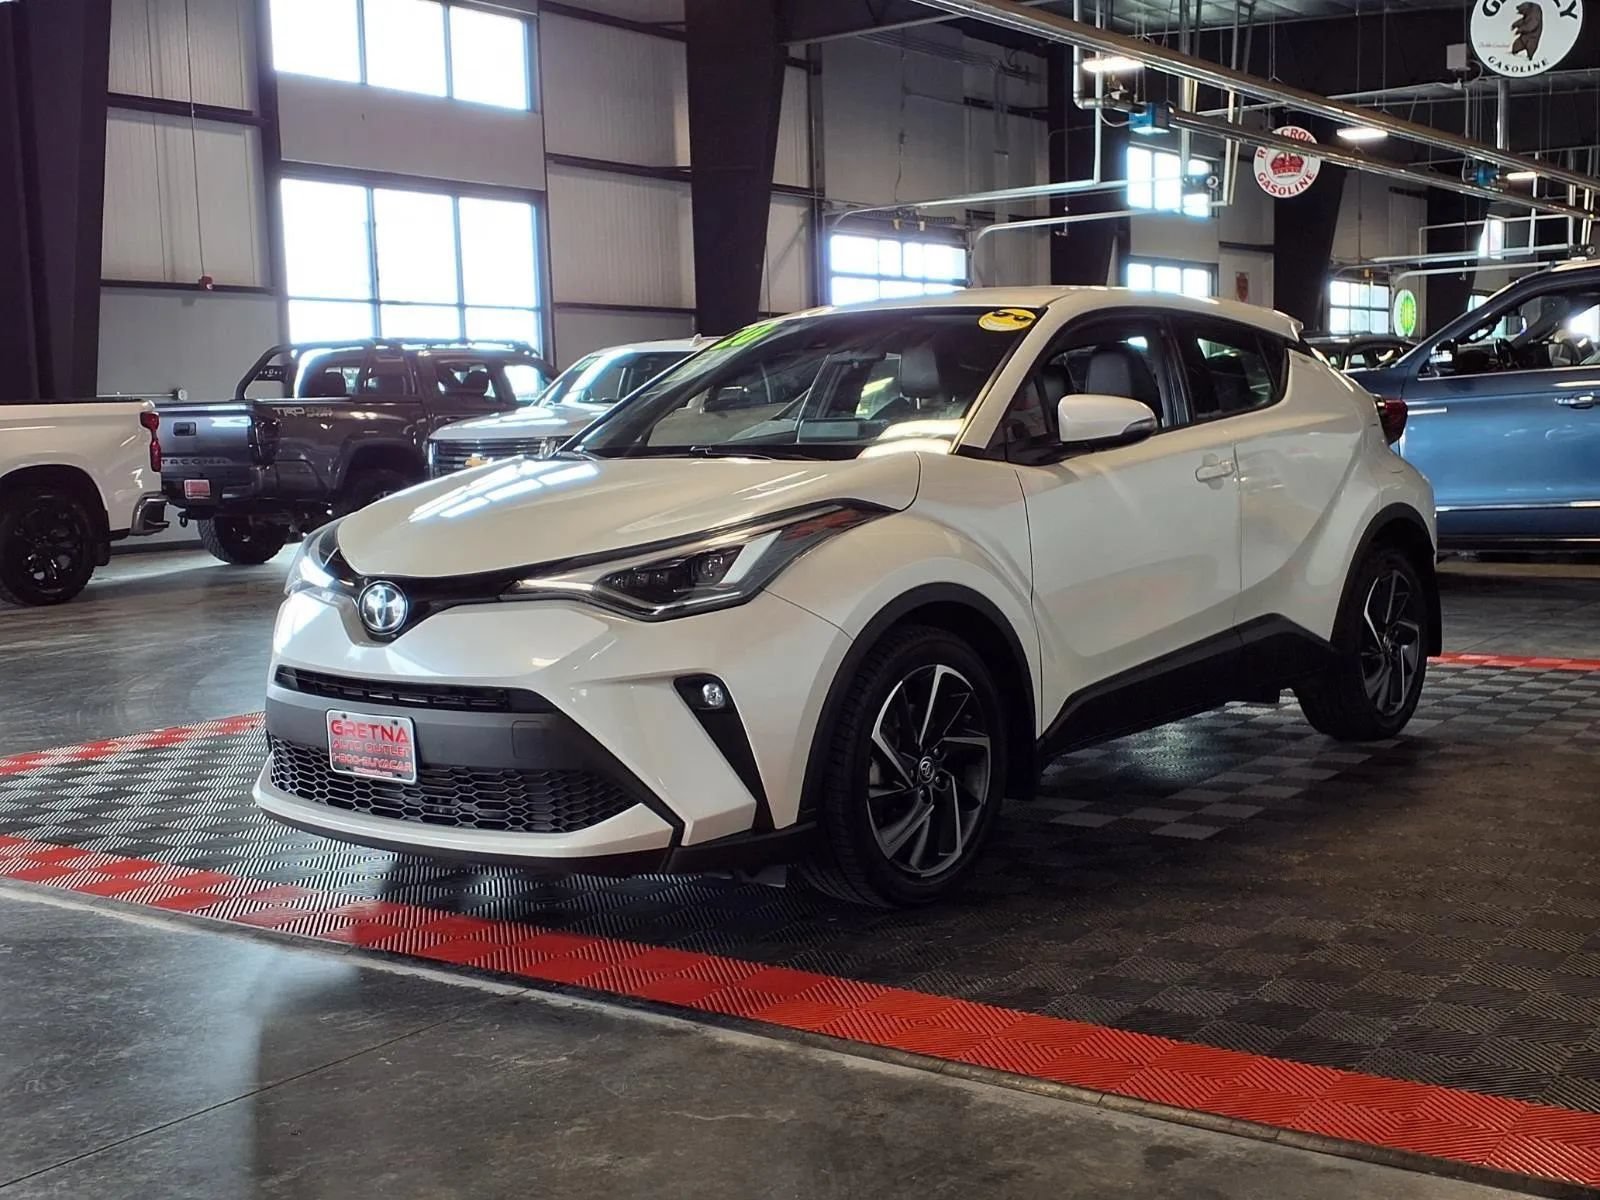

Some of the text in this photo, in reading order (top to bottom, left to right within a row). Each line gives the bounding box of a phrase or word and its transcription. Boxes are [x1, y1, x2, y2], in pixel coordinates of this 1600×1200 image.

[1488, 56, 1549, 73] GASOLINE
[1258, 170, 1315, 196] GASOLINE
[272, 407, 305, 417] TRD
[331, 719, 409, 743] GRETNA
[332, 739, 411, 758] AUTO OUTLET
